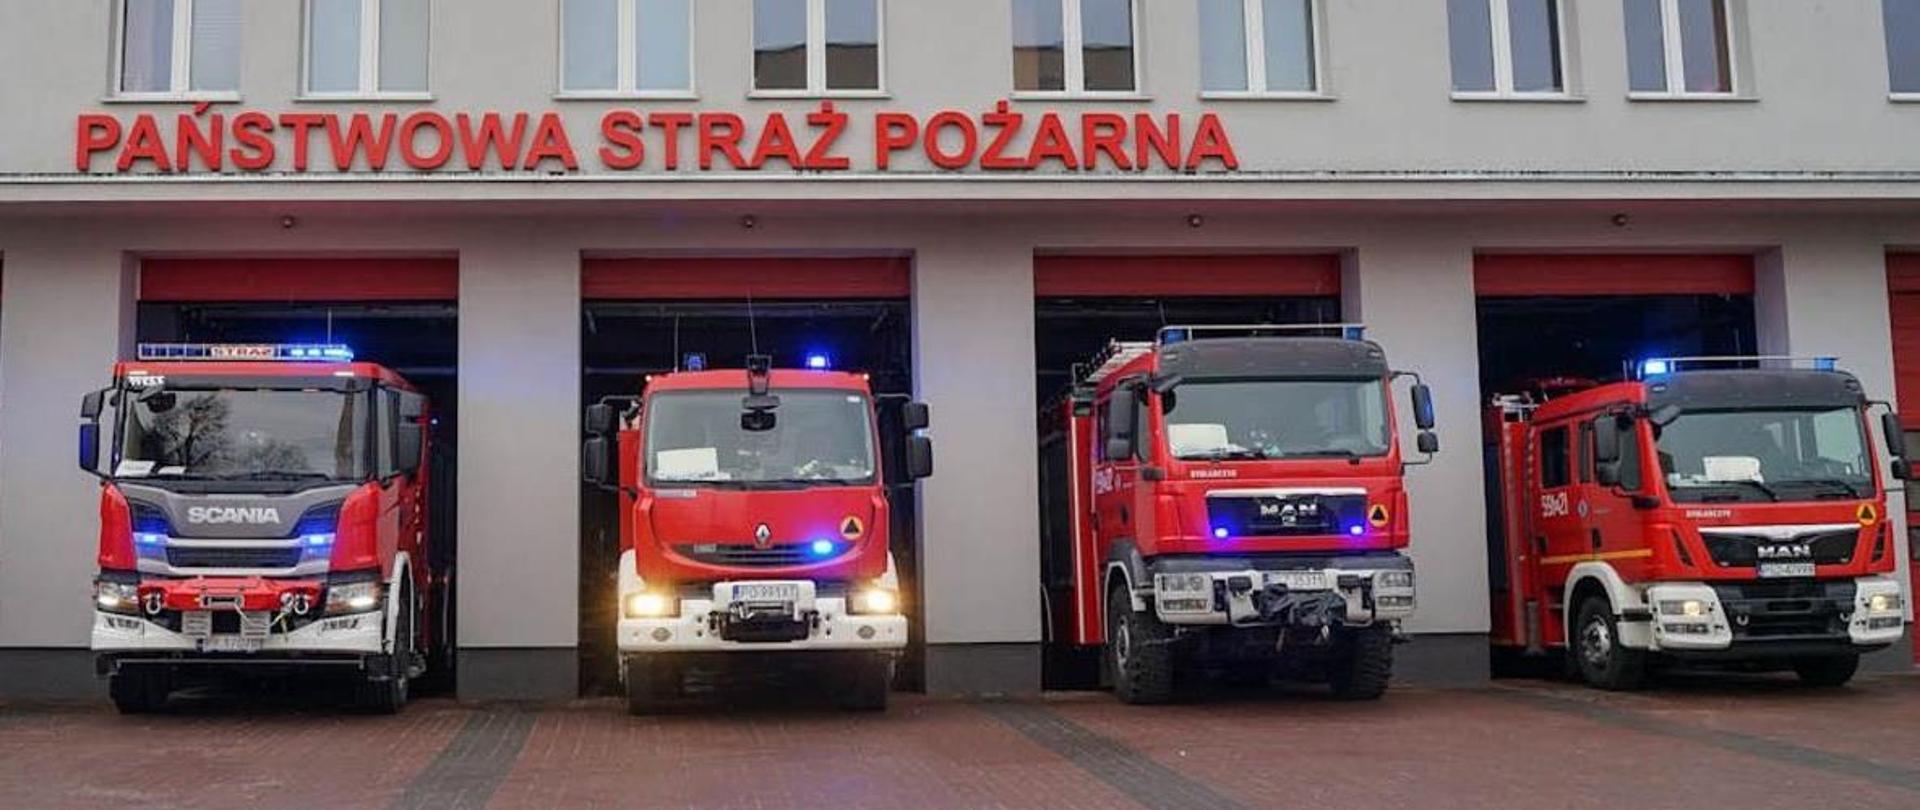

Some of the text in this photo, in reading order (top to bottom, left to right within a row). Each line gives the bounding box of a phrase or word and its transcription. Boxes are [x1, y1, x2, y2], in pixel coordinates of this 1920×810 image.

[77, 100, 1239, 171] PAŃSTWOWA STRAŻ POŻARNA
[187, 506, 280, 524] SCANIA
[1260, 504, 1317, 516] MAN
[1757, 545, 1811, 558] MAN
